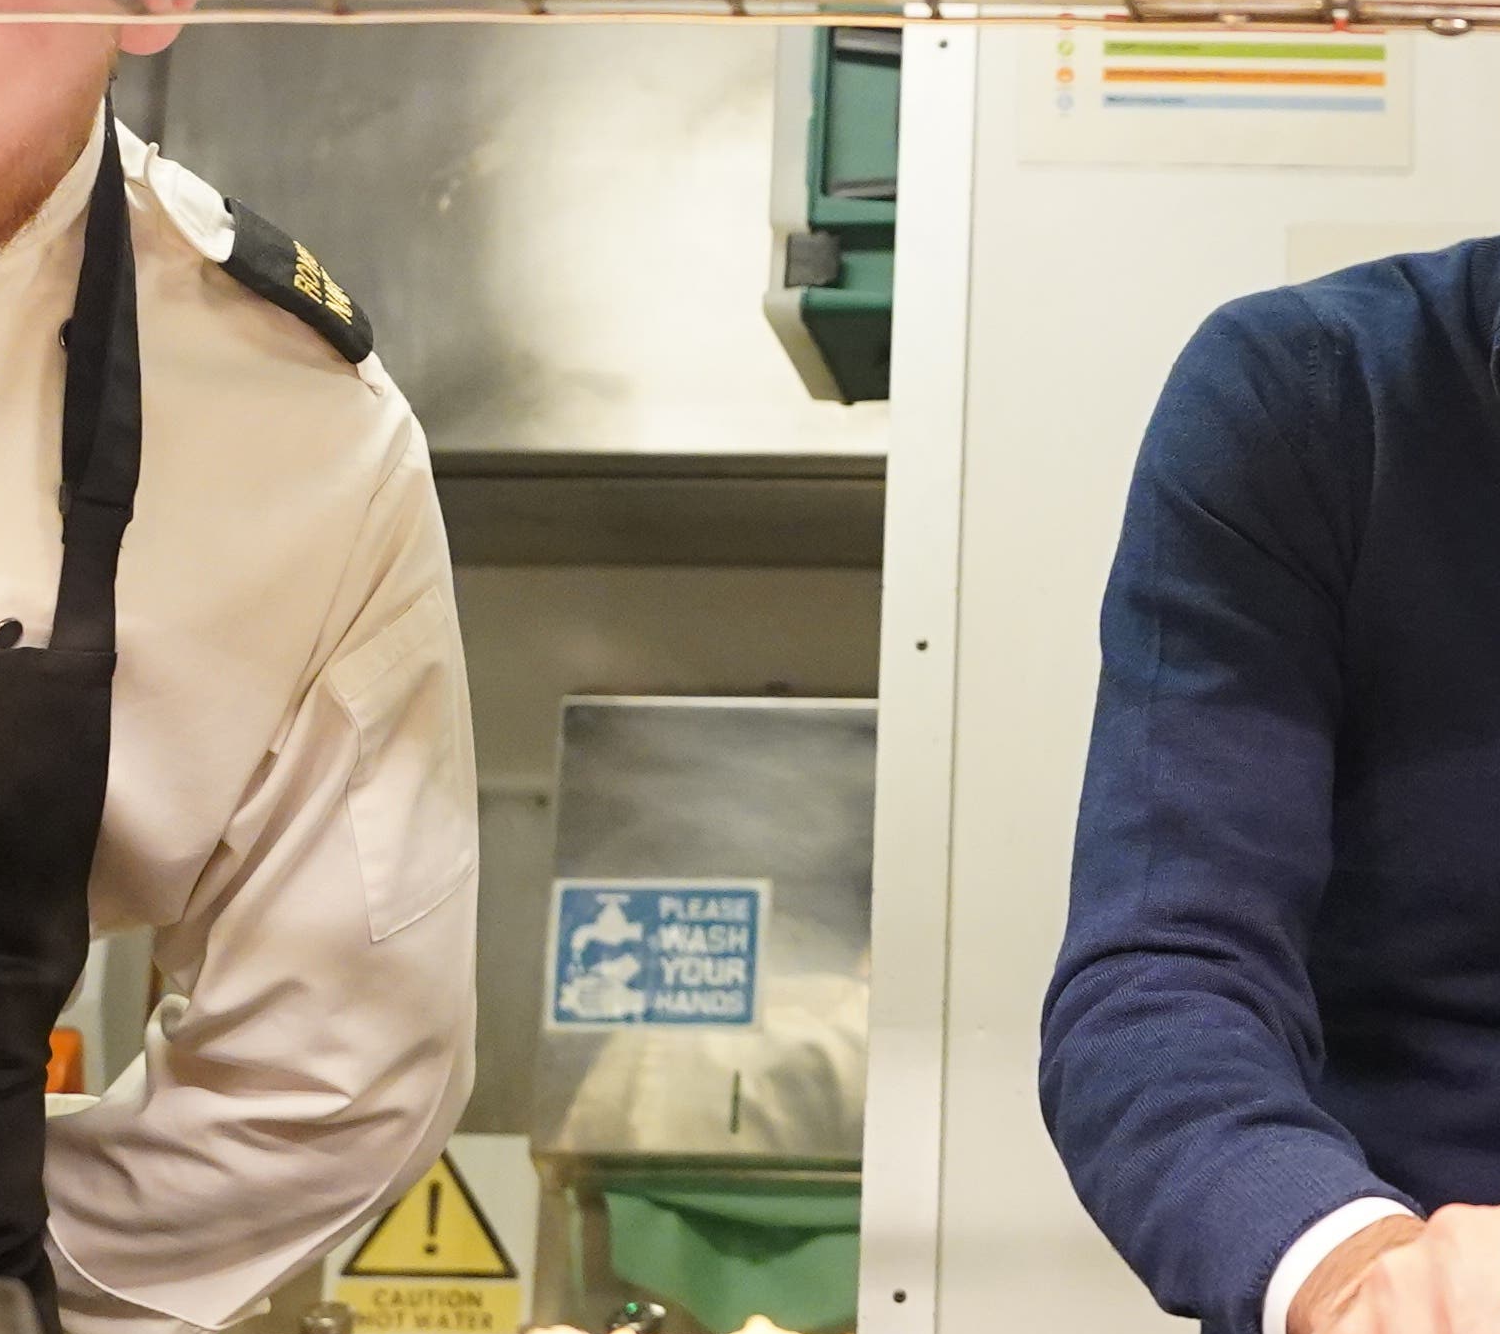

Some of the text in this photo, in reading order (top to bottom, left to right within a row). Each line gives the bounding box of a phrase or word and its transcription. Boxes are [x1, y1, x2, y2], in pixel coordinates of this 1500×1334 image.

[658, 896, 749, 922] PLEASE
[656, 924, 749, 955] WASH
[660, 956, 747, 987] YOUR
[653, 988, 745, 1017] HANDS
[371, 1288, 484, 1308] CAUTION
[413, 1310, 493, 1331] WATER
